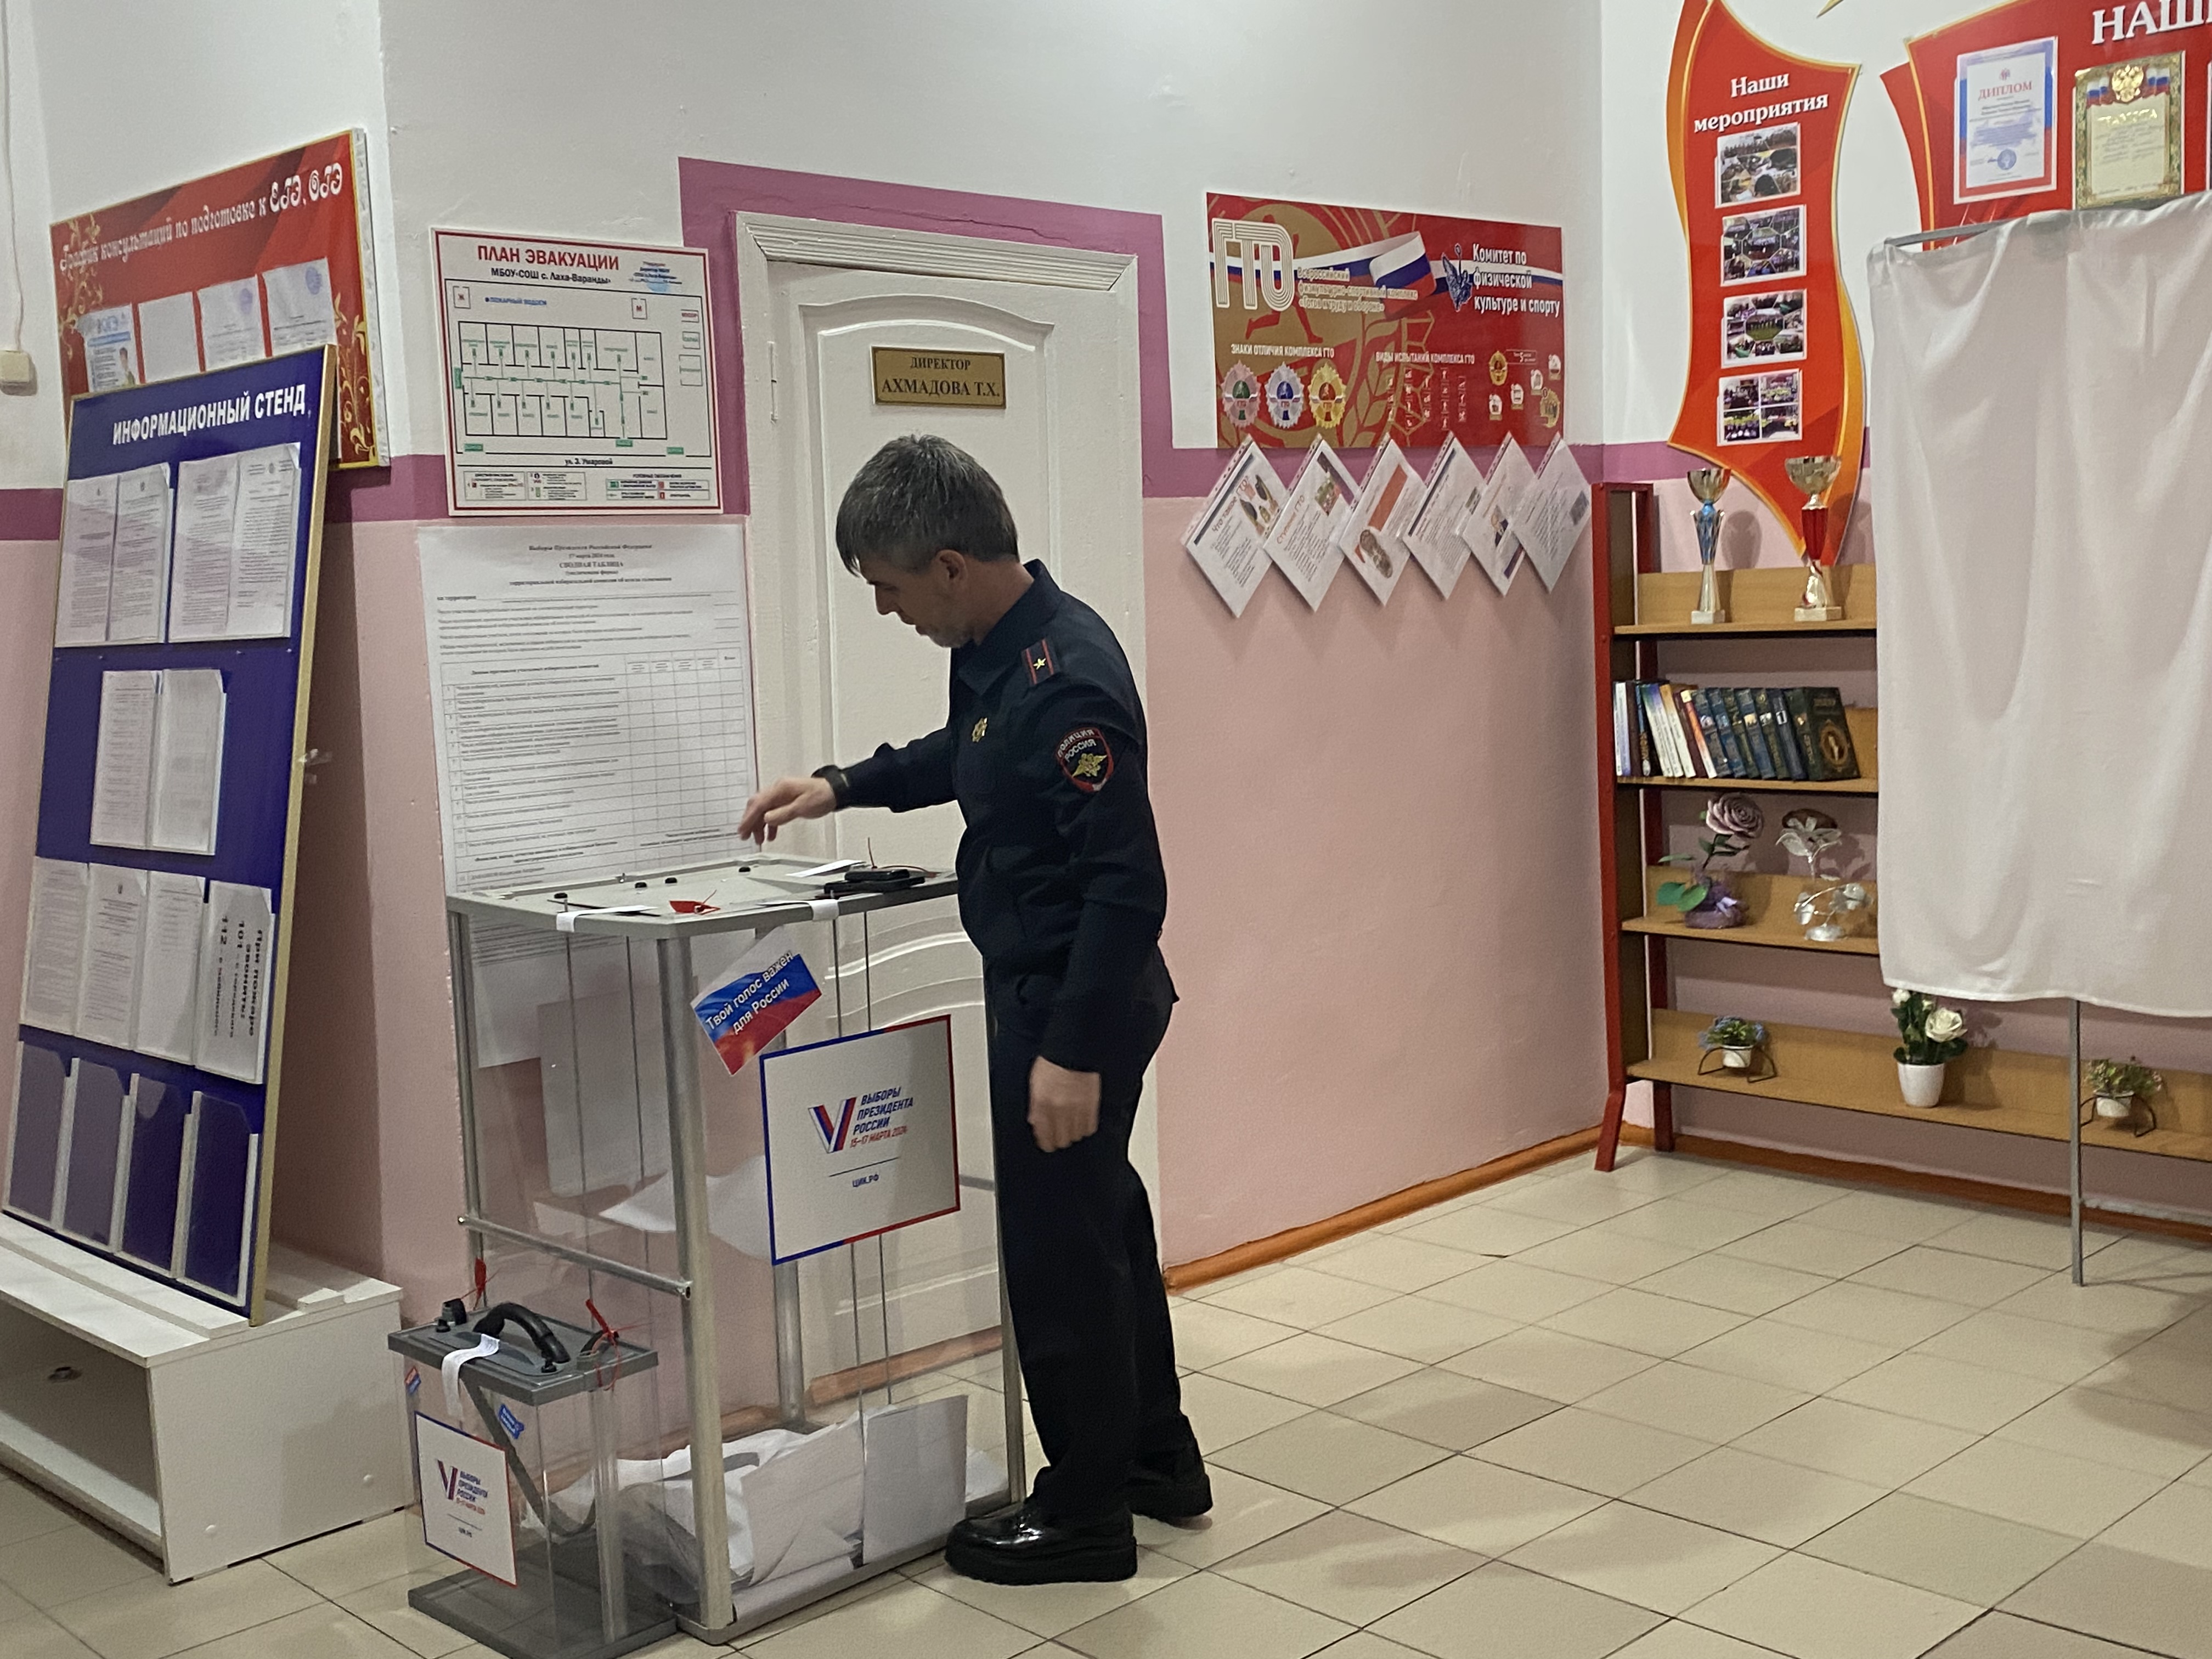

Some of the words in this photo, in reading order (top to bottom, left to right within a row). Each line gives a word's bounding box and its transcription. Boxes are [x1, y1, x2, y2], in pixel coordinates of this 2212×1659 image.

[2092, 0, 2212, 44] НАШ
[1731, 73, 1790, 98] Наши
[1978, 81, 2033, 101] ДИПЛОМ
[1694, 94, 1829, 133] мероприятия
[176, 221, 188, 239] по
[191, 205, 255, 235] подготовке
[259, 197, 267, 217] к
[308, 162, 343, 201] ОГЭ
[478, 245, 520, 263] ПЛАН
[524, 249, 619, 271] ЭВАКУАЦИИ
[1212, 218, 1295, 312] ГТО
[1473, 244, 1514, 264] Комитет
[1515, 251, 1527, 265] по
[1473, 267, 1533, 290] физической
[1474, 296, 1518, 315] культуре
[1520, 298, 1527, 312] и
[1528, 300, 1560, 318] спорту
[1231, 343, 1252, 354] ЗНАКИ
[1254, 345, 1283, 356] ОТЛИЧИЯ
[1284, 346, 1322, 357] КОМПЛЕКСА
[1323, 347, 1335, 358] ГТО
[1376, 352, 1393, 363] ВИДЫ
[1464, 354, 1475, 364] ГТО
[910, 357, 970, 371] ДИРЕКТОР
[882, 379, 970, 397] АХМАДОВА
[112, 390, 251, 445] ИНФОРМАЦИОННЫЙ
[254, 384, 306, 419] СТЕНД
[1057, 729, 1095, 758] ПОЛИЦИЯ
[1064, 738, 1097, 763] РОССИЯ
[237, 921, 245, 949] 101
[705, 1003, 733, 1030] Твой
[733, 979, 763, 1008] голос
[762, 950, 793, 983] важен
[733, 1011, 753, 1035] для
[751, 978, 790, 1014] России
[856, 1097, 914, 1121] ПРЕЗИДЕНТА
[860, 1086, 902, 1107] ВЫБОРЫ
[853, 1116, 891, 1136] РОССИИ
